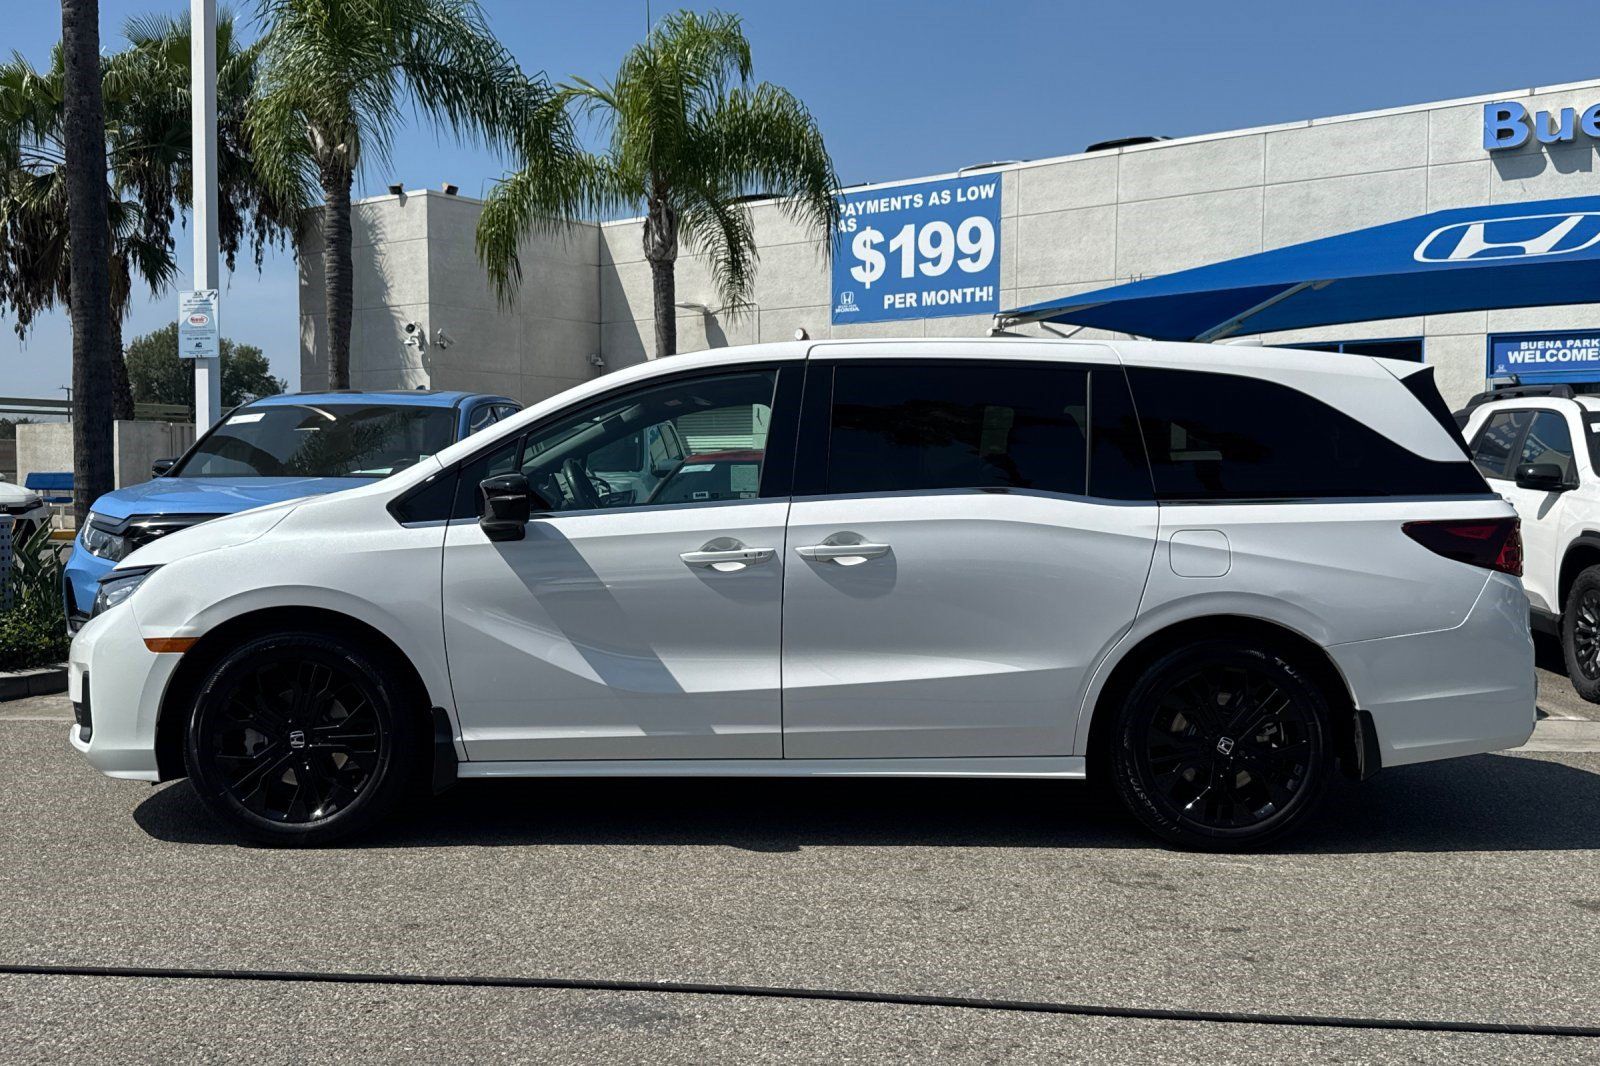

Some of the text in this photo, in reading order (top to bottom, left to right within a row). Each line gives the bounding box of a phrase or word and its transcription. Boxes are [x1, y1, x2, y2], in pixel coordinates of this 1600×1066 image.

[838, 183, 996, 217] PAYMENTS AS LOW
[850, 216, 995, 290] $199
[883, 286, 994, 310] PER MONTH!
[1507, 347, 1600, 364] WELCOME
[1520, 338, 1600, 350] BUENA PARK
